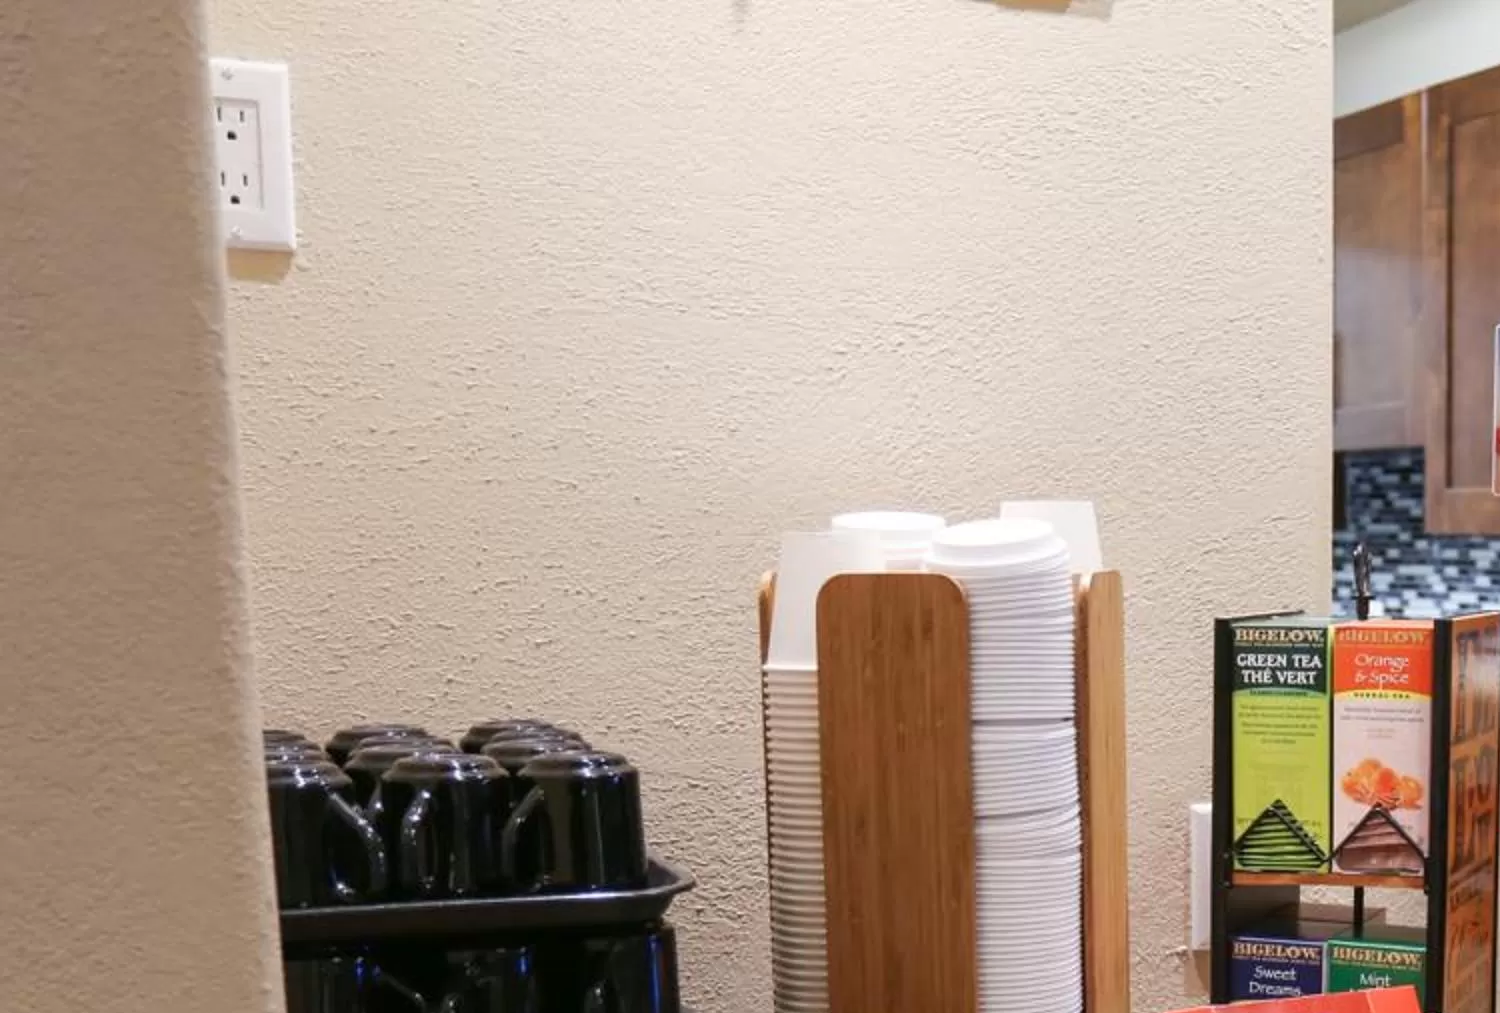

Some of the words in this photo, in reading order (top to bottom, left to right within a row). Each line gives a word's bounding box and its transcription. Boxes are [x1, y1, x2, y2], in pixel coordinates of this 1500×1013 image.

[1234, 628, 1324, 643] BIGELOW
[1236, 653, 1288, 668] GREEN
[1291, 654, 1323, 669] TEA
[1355, 652, 1410, 673] Orange
[1275, 671, 1318, 685] VERT
[1368, 671, 1410, 691] Spice
[1232, 941, 1321, 960] BIGELOW
[1331, 946, 1422, 966] BIGELOW
[1254, 965, 1298, 981] Sweet
[1359, 972, 1393, 987] Mint
[1248, 981, 1303, 996] Dreams
